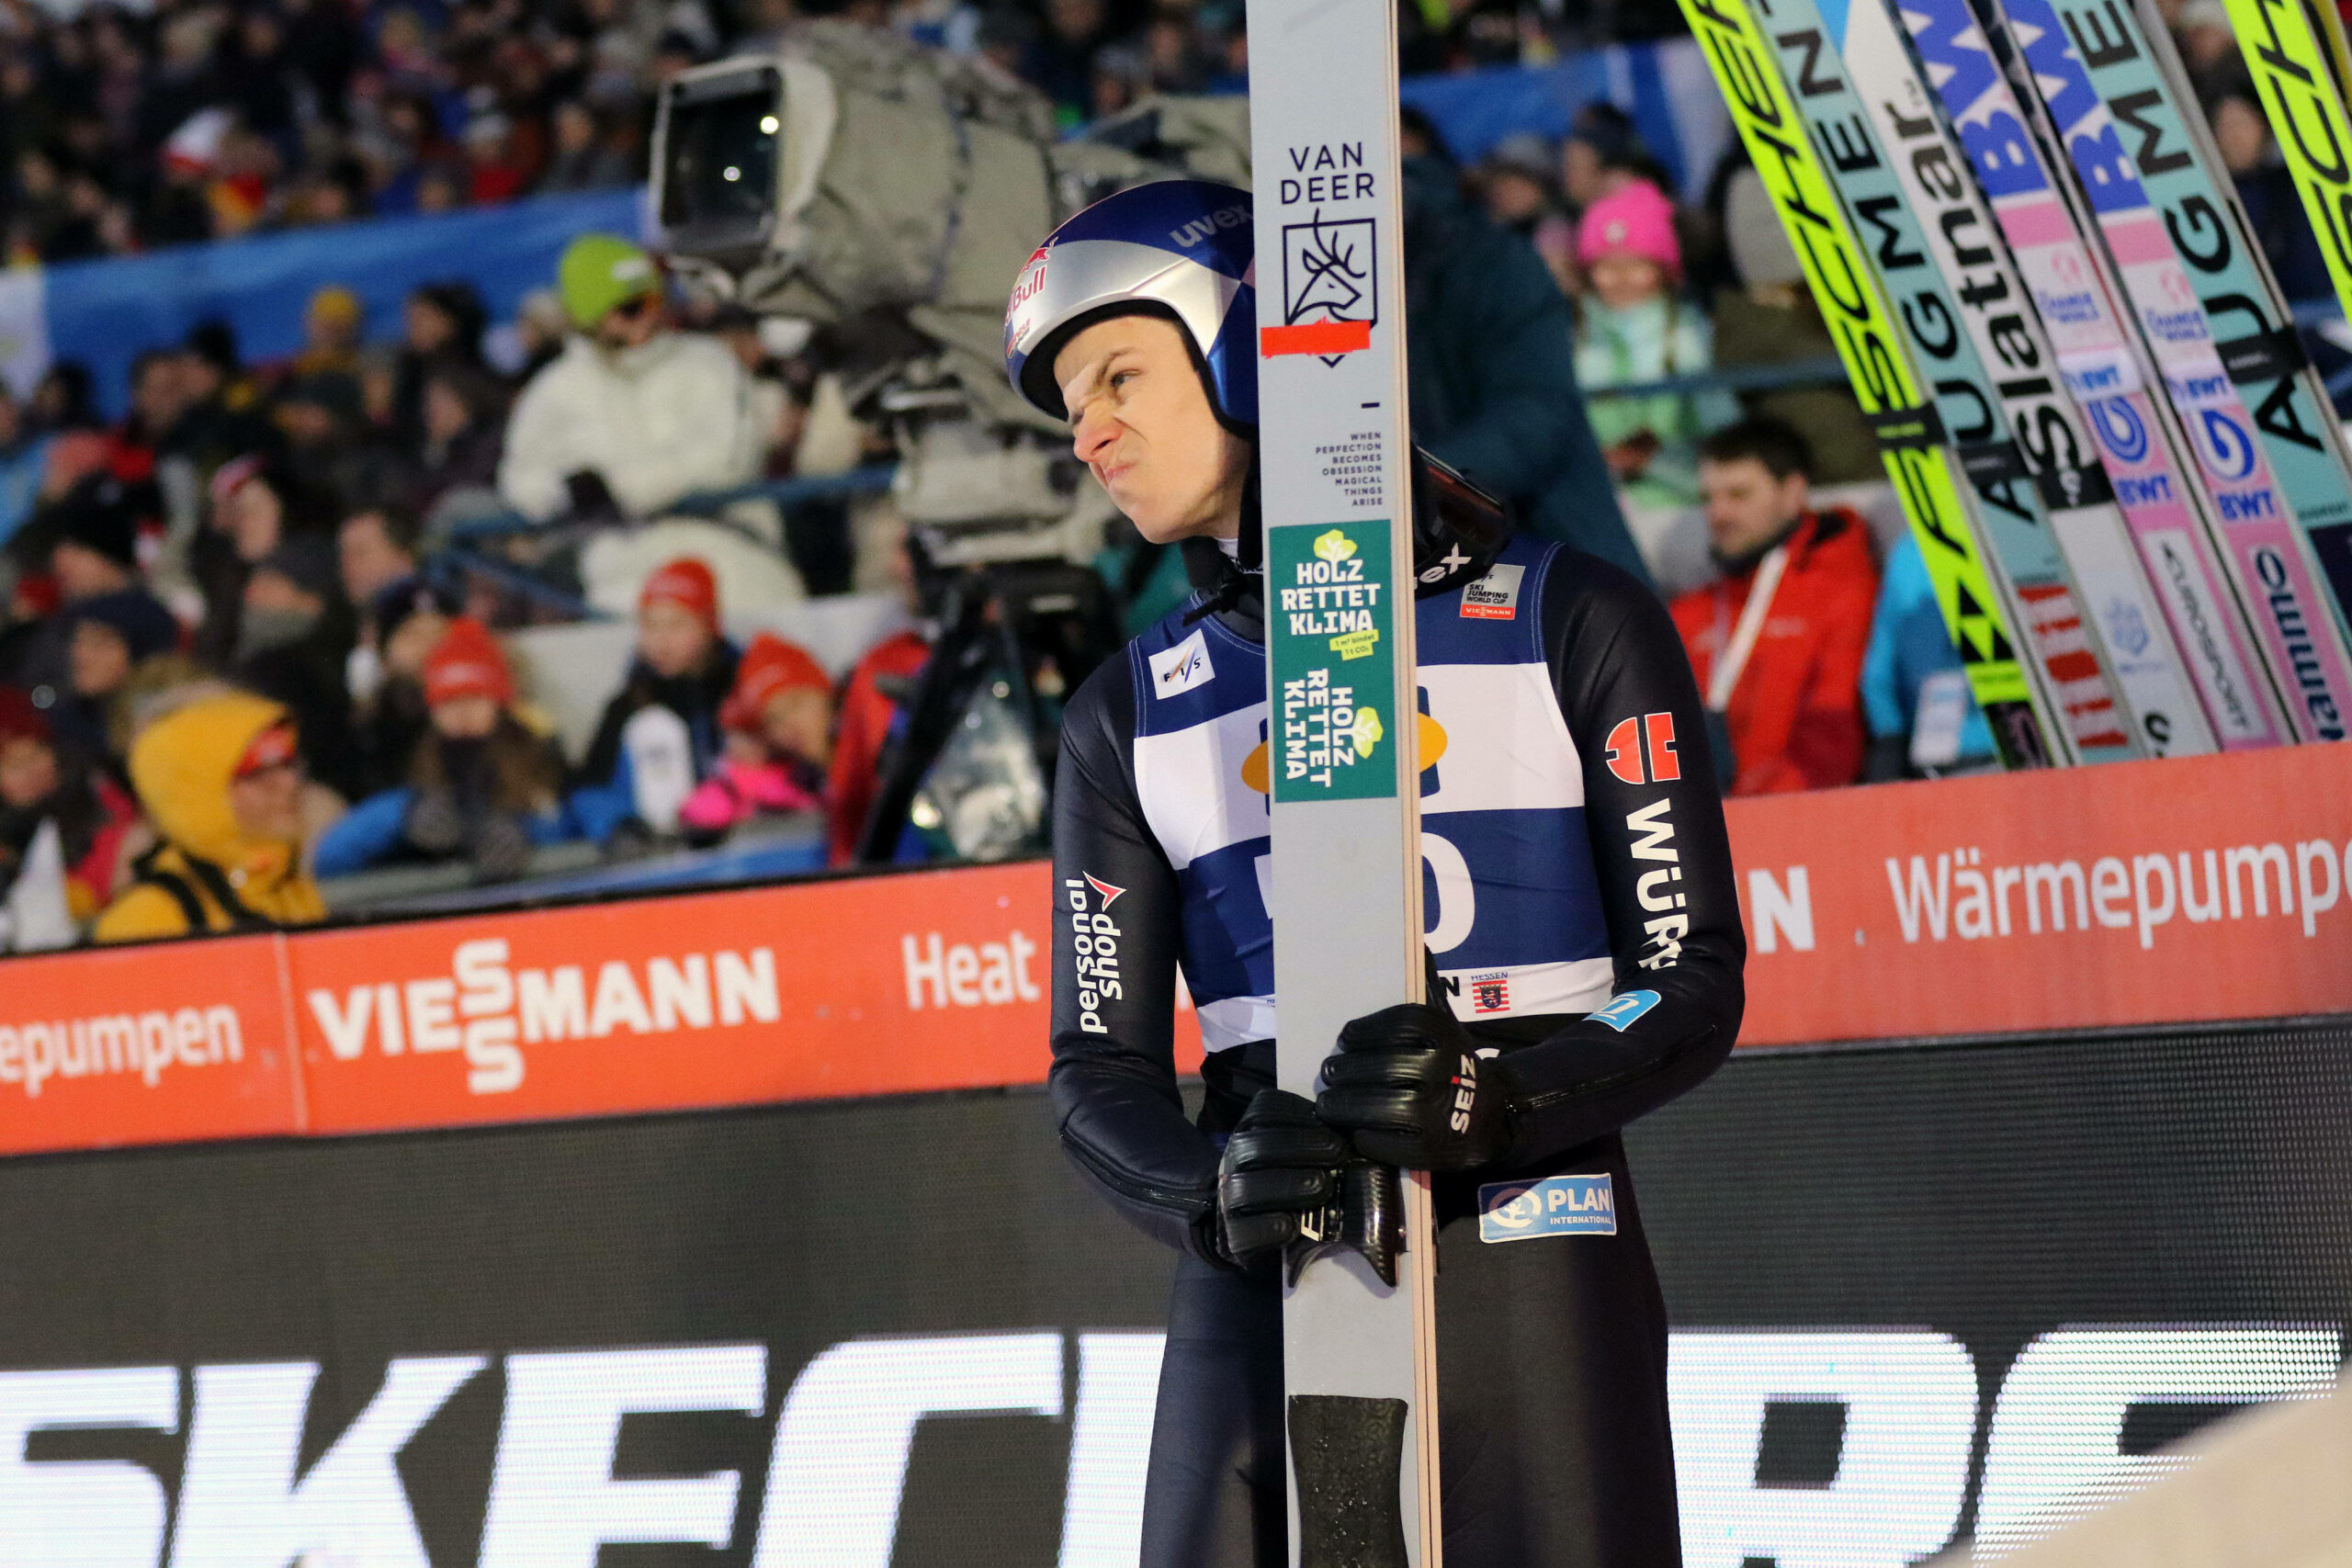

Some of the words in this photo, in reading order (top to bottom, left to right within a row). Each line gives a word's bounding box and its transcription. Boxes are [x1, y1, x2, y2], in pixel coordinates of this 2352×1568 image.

[1289, 141, 1362, 173] VAN
[1281, 173, 1374, 205] DEER
[1883, 101, 2080, 475] Slatnar
[1315, 443, 1381, 455] PERFECTION
[1350, 432, 1381, 441] WHEN
[1322, 465, 1382, 476] OBSESSION
[1332, 454, 1382, 465] BECOMES
[1335, 476, 1382, 486] MAGICAL
[1344, 487, 1382, 496] THINGS
[2117, 476, 2172, 505] BWT
[1351, 497, 1382, 507] ARISE
[2218, 491, 2275, 521] BWT
[1296, 558, 1364, 585] HOLZ
[1280, 582, 1382, 611] RETTET
[1466, 596, 1491, 604] WORLD
[1467, 589, 1509, 599] JUMPING
[1289, 609, 1374, 636] KLIMA
[1284, 680, 1307, 780] KLIMA
[1307, 668, 1331, 788] RETTET
[1331, 686, 1354, 767] HOLZ
[1066, 879, 1108, 1034] personal
[1090, 913, 1123, 1000] shop
[901, 930, 1041, 1011] Heat
[1471, 972, 1508, 982] HESSEN
[307, 937, 782, 1096] VIESSMANN
[1548, 1188, 1611, 1213] PLAN
[1550, 1215, 1612, 1225] INTERNATIONAL
